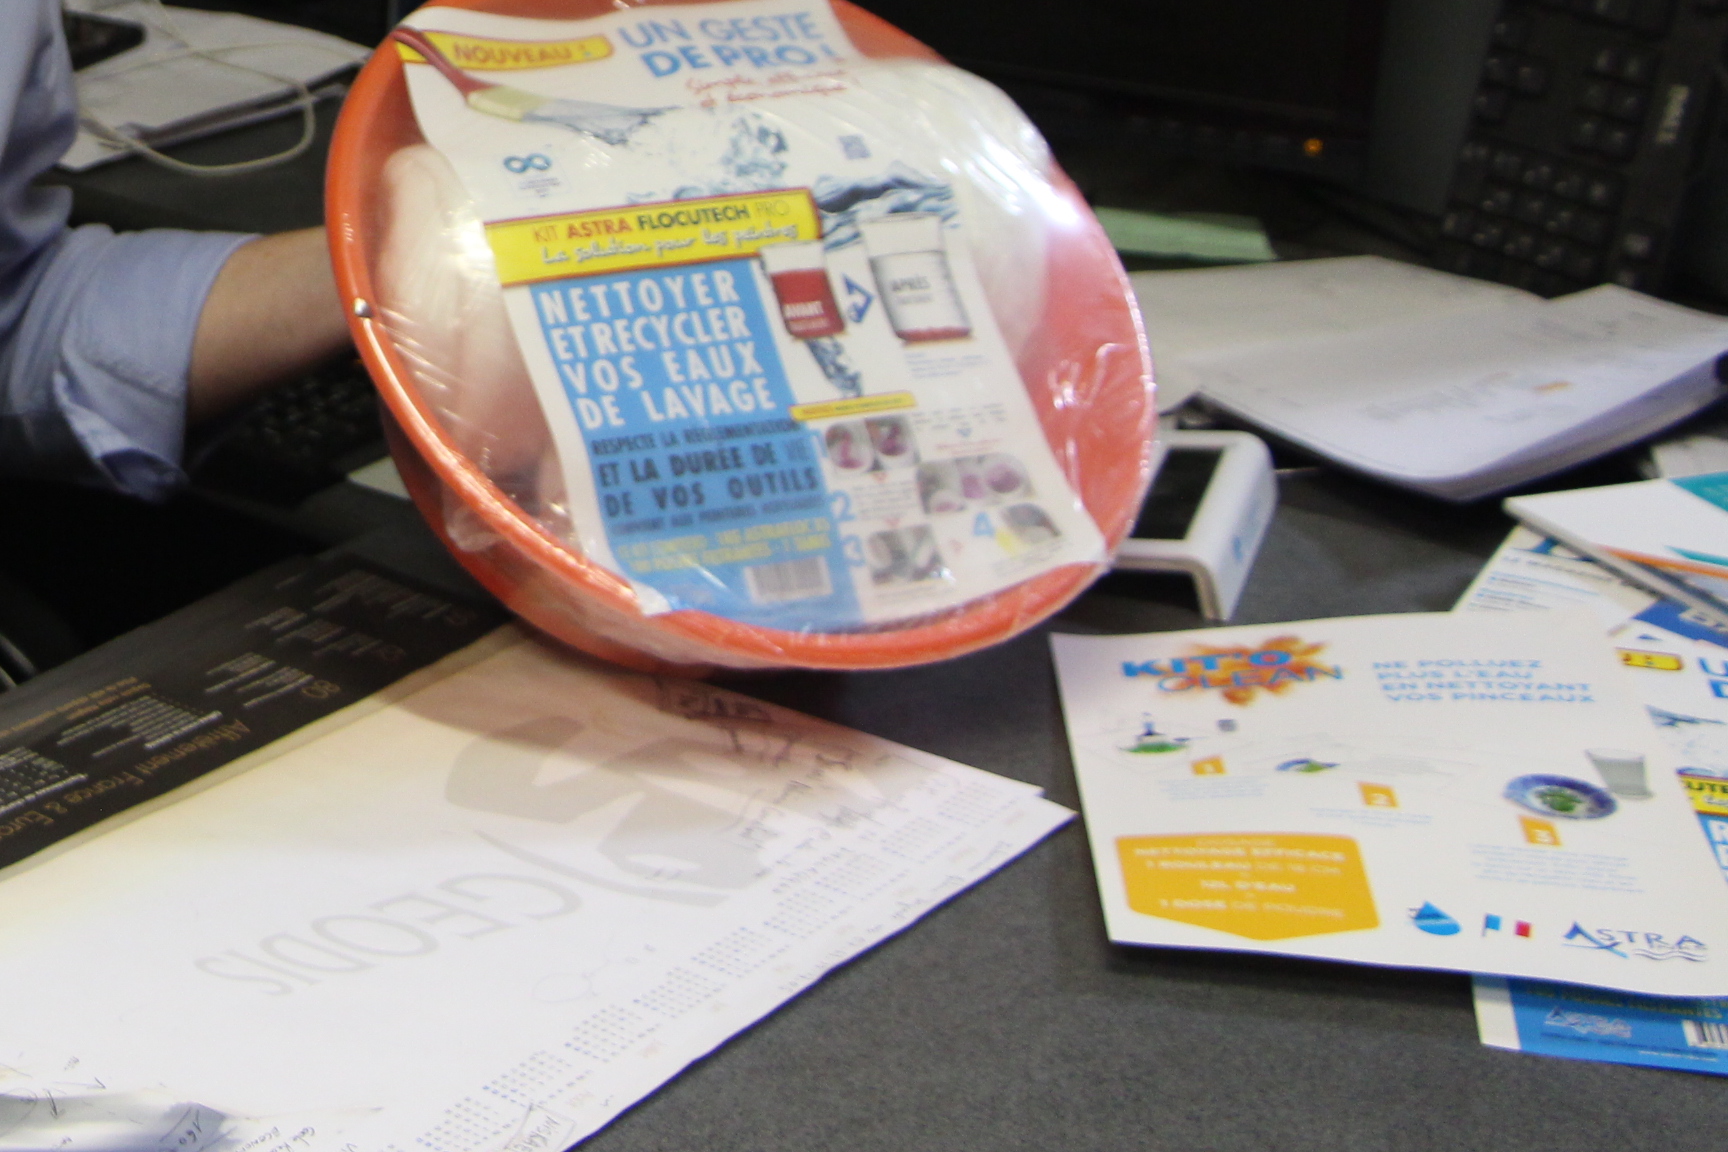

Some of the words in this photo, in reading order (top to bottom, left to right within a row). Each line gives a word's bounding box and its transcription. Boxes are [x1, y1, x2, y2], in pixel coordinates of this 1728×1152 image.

[618, 18, 689, 50] UN
[698, 12, 824, 43] GESTE
[454, 41, 576, 67] NOUVEAU
[640, 46, 712, 78] DE
[709, 45, 819, 71] PRO
[533, 226, 560, 243] KIT
[566, 217, 633, 240] ASTRA
[638, 204, 752, 232] FLOCUTECH
[755, 199, 792, 219] PRO
[542, 244, 570, 266] La
[575, 237, 650, 263] solution
[655, 235, 696, 260] pour
[700, 226, 730, 248] les
[539, 270, 741, 325] NETTOYER
[549, 325, 589, 360] ET
[590, 305, 752, 356] RECYCLER
[561, 355, 644, 395] VOS
[661, 341, 765, 385] EAUX
[574, 395, 626, 430] DE
[641, 377, 776, 423] LAVAGE
[599, 461, 621, 488] ET
[630, 456, 661, 483] LA
[669, 444, 746, 477] DURÉE
[604, 490, 635, 519] DE
[652, 481, 706, 511] VOS
[726, 466, 821, 501] OUTILS
[1121, 649, 1294, 678] KIT'O
[1157, 664, 1345, 693] CLEAN
[1417, 658, 1544, 670] POLLUEZ
[1381, 681, 1418, 693] EN
[1426, 681, 1591, 694] NETTOYANT
[1387, 692, 1443, 703] VOS
[1451, 691, 1597, 704] PINCEAUX
[194, 872, 584, 998] GEODIS
[1561, 920, 1710, 960] ASTRA
